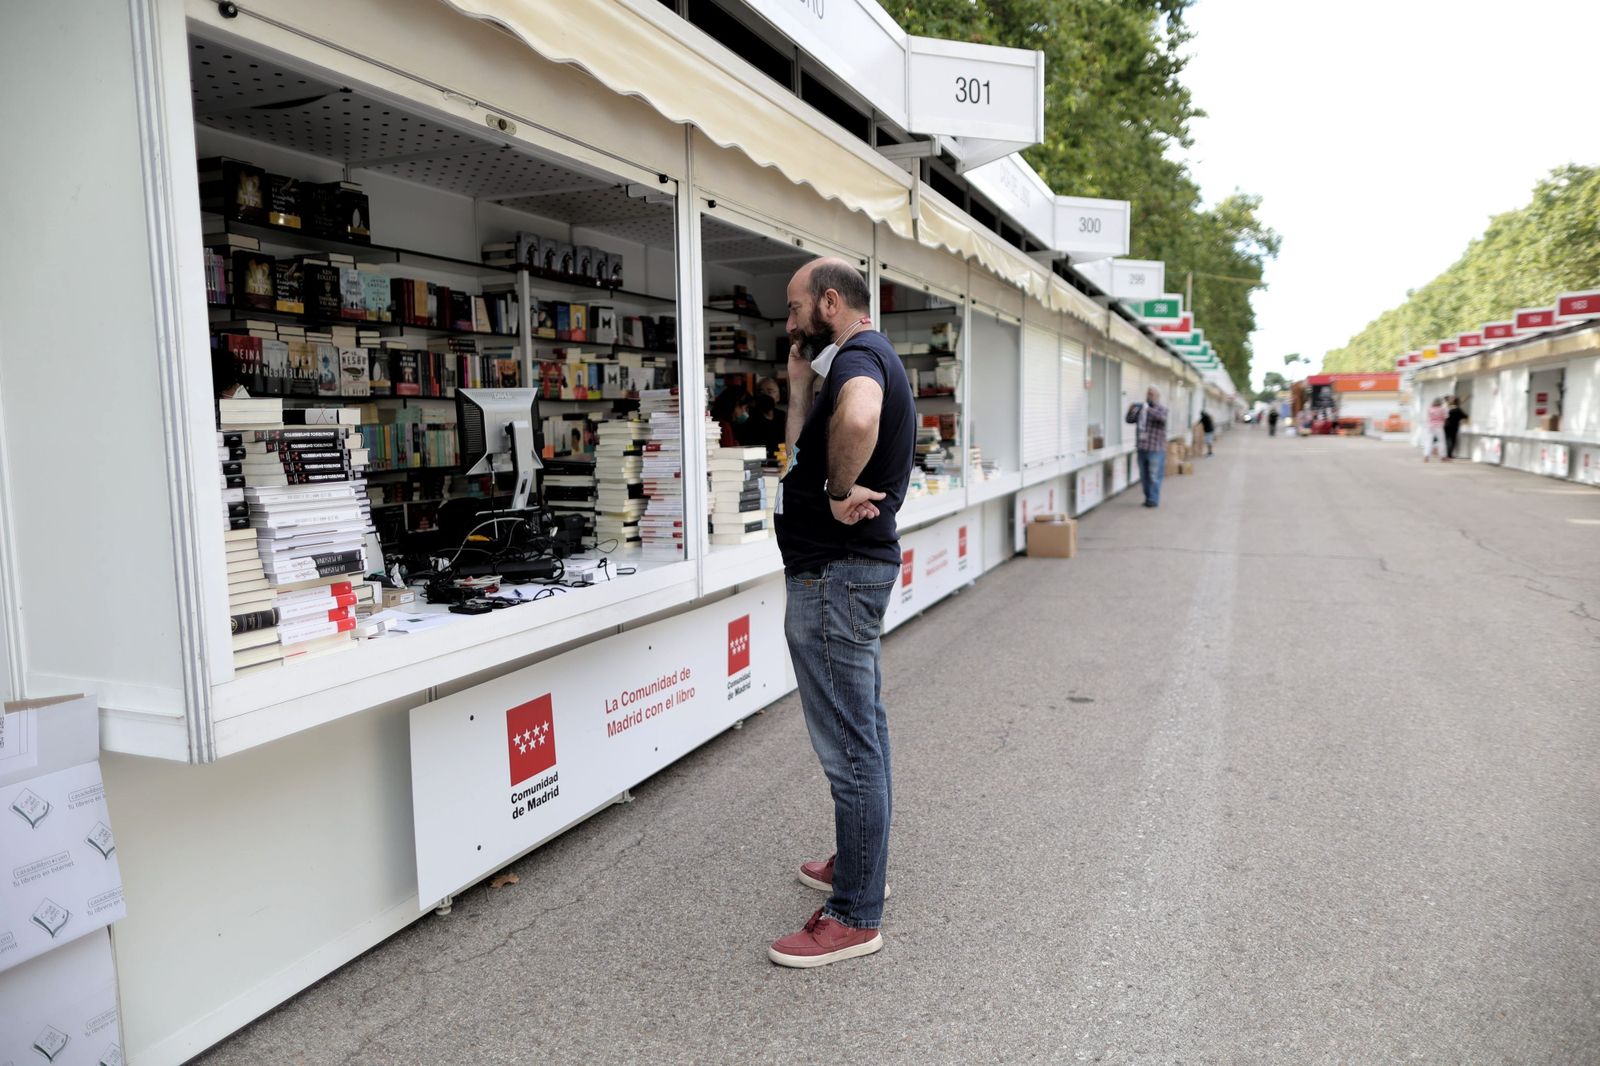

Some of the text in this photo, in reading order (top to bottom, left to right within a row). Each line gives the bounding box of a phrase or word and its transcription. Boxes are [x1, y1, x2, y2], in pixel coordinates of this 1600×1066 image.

[956, 76, 990, 104] 301
[1079, 216, 1101, 234] 300
[605, 667, 690, 714] La Comunidad de
[727, 670, 751, 690] Comunidad
[735, 680, 751, 697] Madrid
[608, 687, 696, 738] Madrid con el libro
[511, 771, 558, 804] Comunidad
[512, 785, 560, 820] de Madrid
